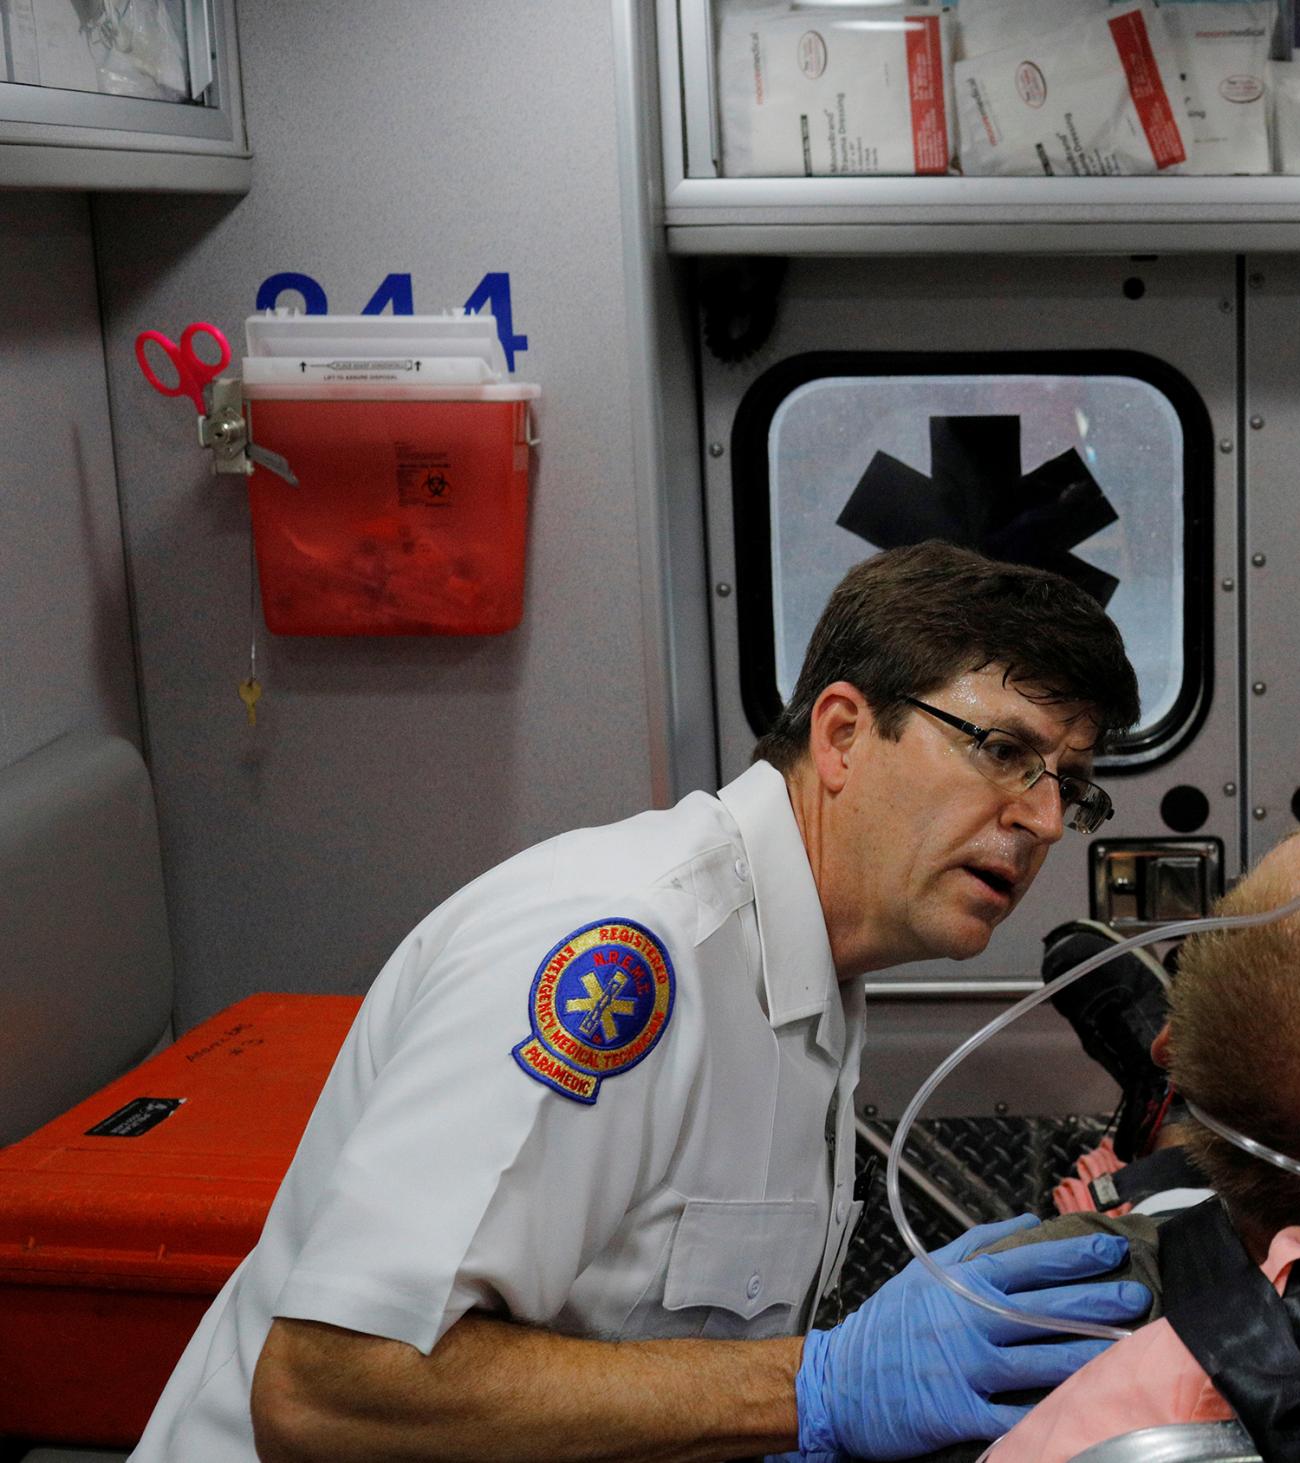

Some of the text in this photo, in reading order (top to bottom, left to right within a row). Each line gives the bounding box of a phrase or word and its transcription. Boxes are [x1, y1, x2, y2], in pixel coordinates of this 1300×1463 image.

[599, 927, 667, 985] REGISTERED
[537, 945, 665, 1069] EMERGENCY MEDICAL TECHNICIAN
[523, 1045, 592, 1095] PARAMEDIC
